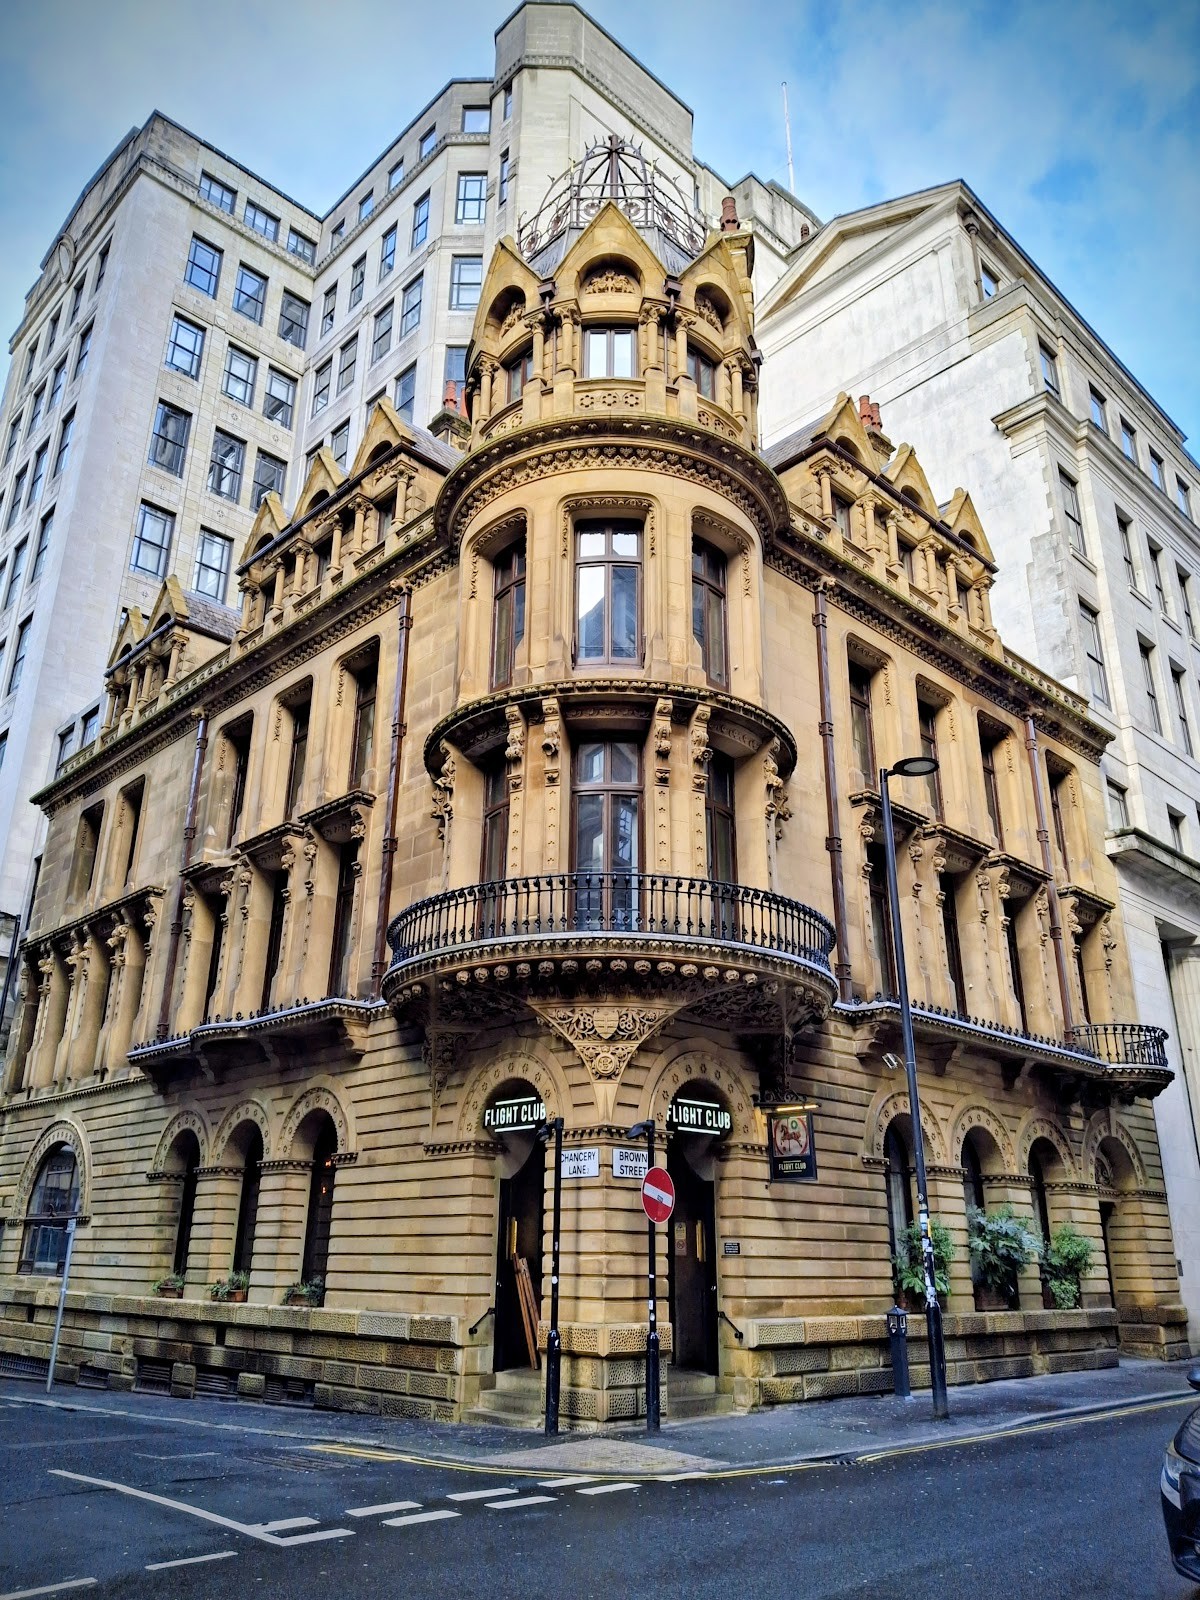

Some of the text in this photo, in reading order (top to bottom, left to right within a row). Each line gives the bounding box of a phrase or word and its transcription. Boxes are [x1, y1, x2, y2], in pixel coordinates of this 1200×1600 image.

[484, 1102, 546, 1127] FLIGHT CLUB
[666, 1104, 731, 1129] FLIGHT CLUB
[561, 1151, 596, 1163] CHANCERY
[619, 1151, 648, 1163] BROWN
[568, 1164, 587, 1175] LANE
[619, 1164, 647, 1177] STREET
[778, 1162, 807, 1171] FLIGHT CLUB
